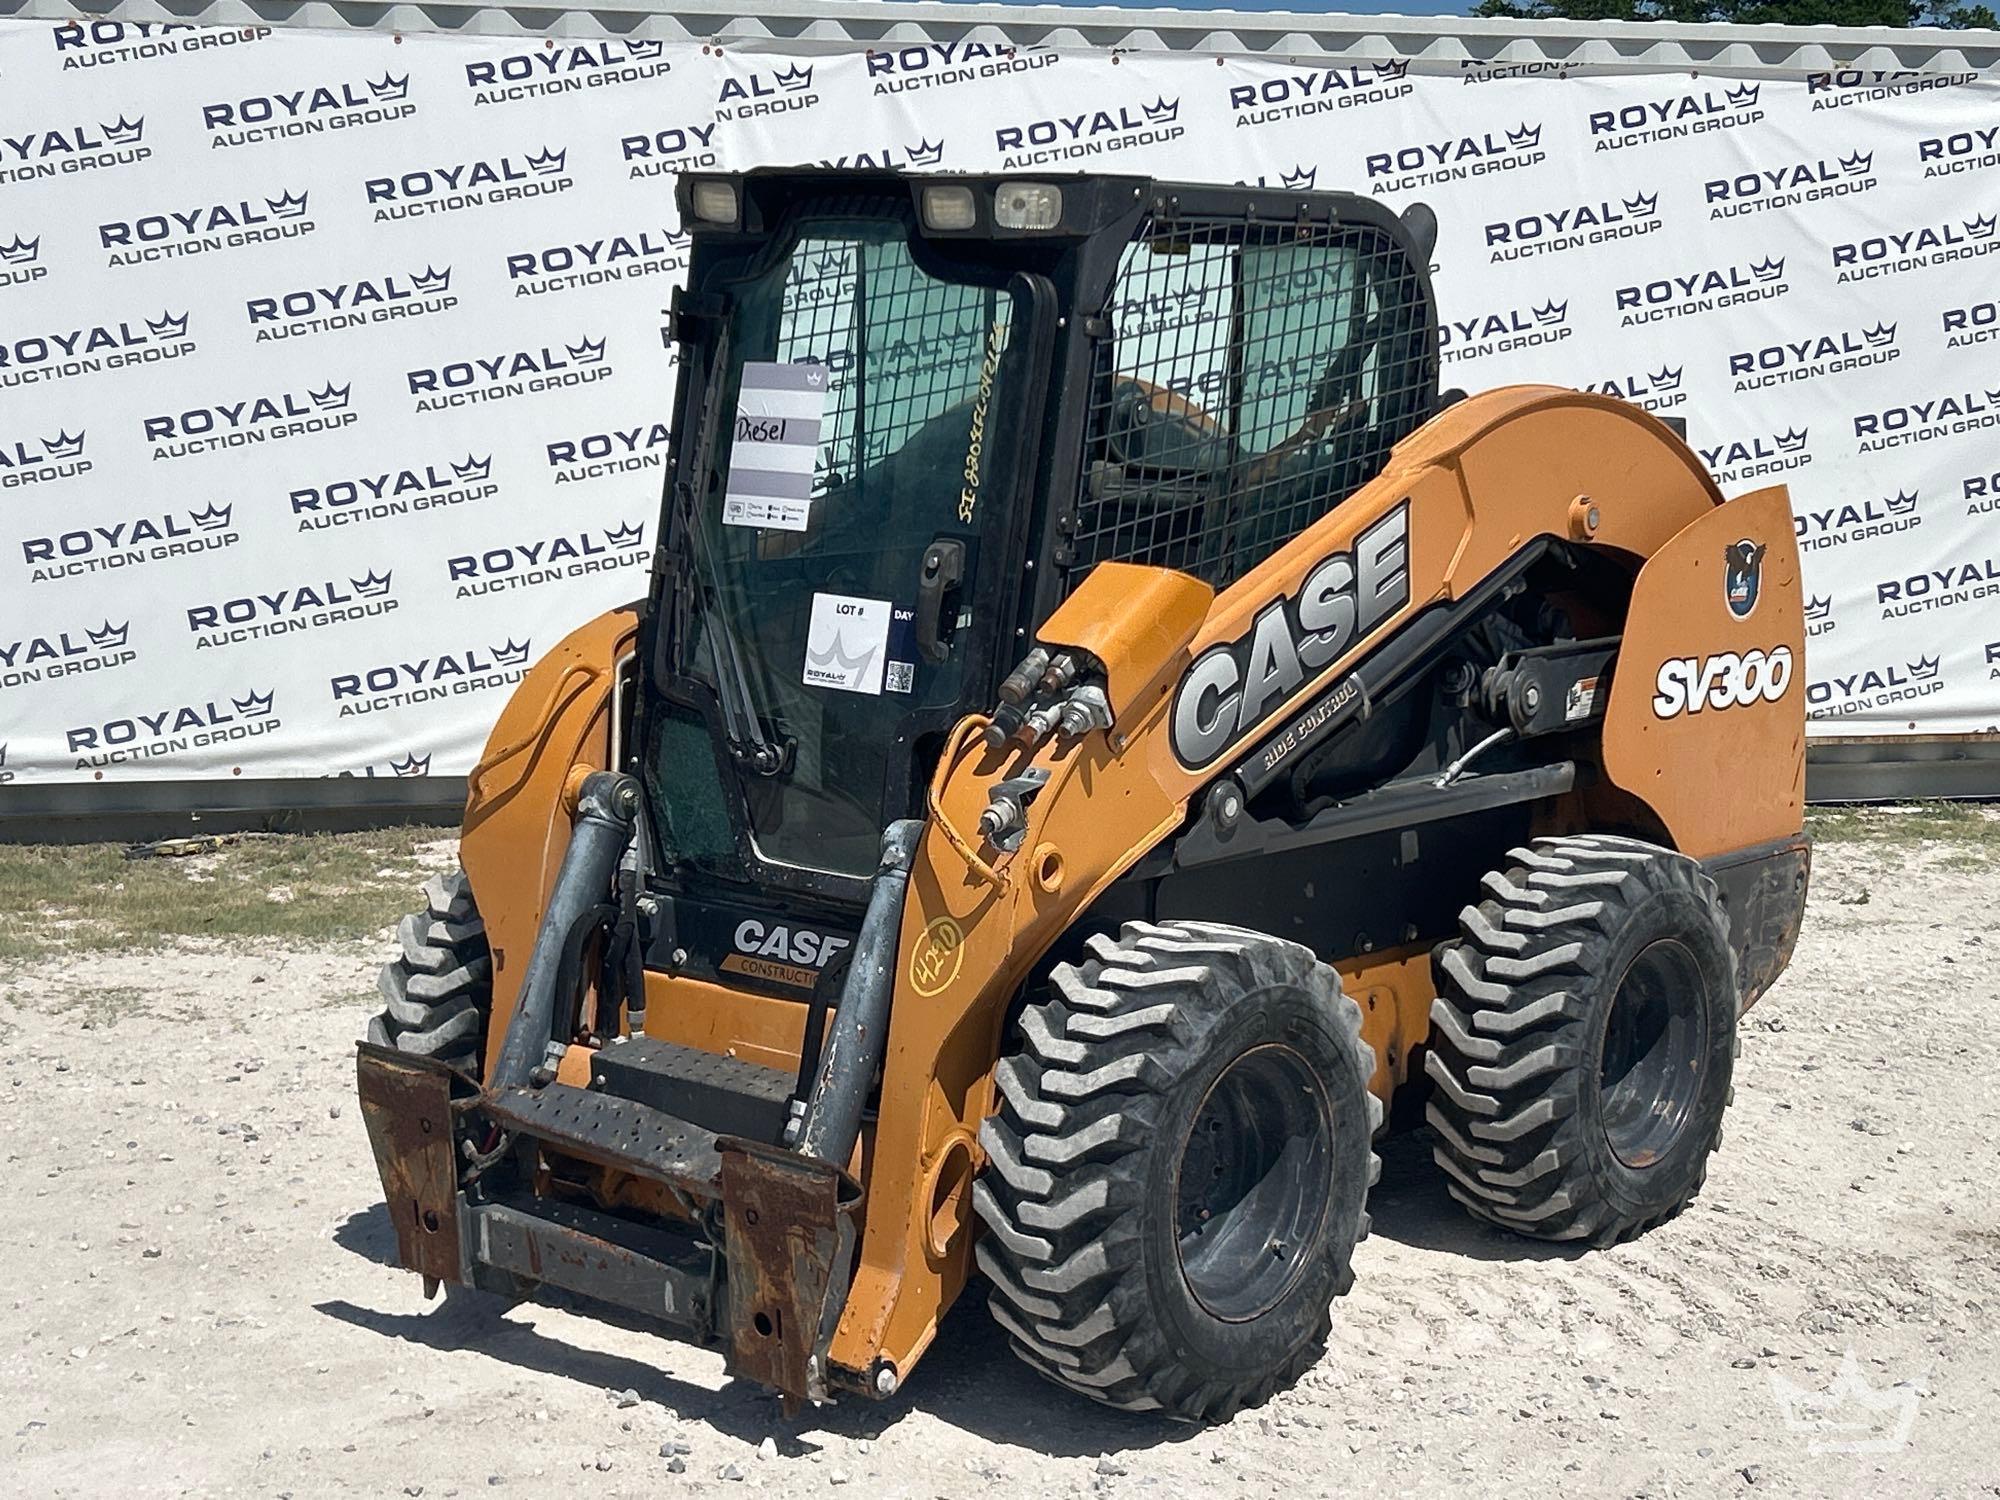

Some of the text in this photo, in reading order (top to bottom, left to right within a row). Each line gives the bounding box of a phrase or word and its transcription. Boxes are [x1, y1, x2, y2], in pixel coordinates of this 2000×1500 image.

[63, 27, 272, 70] AUCTION GROUP
[465, 41, 625, 87] ROYAL
[475, 63, 670, 106] AUCTION GROUP
[874, 54, 1059, 96] AUCTION GROUP
[1230, 65, 1374, 109] ROYAL
[1464, 62, 1559, 85] AUCTION
[1812, 73, 1979, 112] AUCTION GROUP
[203, 84, 369, 130] ROYAL
[212, 104, 416, 149] AUCTION GROUP
[738, 95, 819, 118] GROUP
[1236, 84, 1413, 127] AUCTION GROUP
[1590, 92, 1725, 134] ROYAL
[0, 127, 102, 163] YAL
[621, 123, 715, 161] ROY
[996, 107, 1142, 152] ROYAL
[1003, 127, 1184, 170] AUCTION GROUP
[1595, 111, 1764, 152] AUCTION GROUP
[1919, 127, 2000, 162] ROY
[0, 148, 151, 184] TION GROUP
[630, 153, 715, 179] AUCTIO
[1366, 134, 1506, 177] ROYAL
[1372, 152, 1545, 195] AUCTION GROUP
[365, 158, 527, 203] ROYAL
[375, 178, 573, 222] AUCTION GROUP
[1705, 161, 1839, 203] ROYAL
[1710, 178, 1877, 220] AUCTION GROUP
[99, 202, 267, 248] ROYAL
[109, 222, 315, 267] AUCTION GROUP
[1485, 203, 1623, 246] ROYAL
[1491, 220, 1662, 263] AUCTION GROUP
[1833, 225, 1964, 267] ROYAL
[0, 267, 47, 287] OUP
[507, 233, 664, 279] ROYAL
[1837, 256, 1927, 284] AUCTION
[247, 277, 411, 323] ROYAL
[516, 268, 622, 297] AUCTION
[1616, 267, 1750, 310] ROYAL
[256, 297, 458, 342] AUCTION GROUP
[1621, 284, 1788, 327] AUCTION GROUP
[1443, 328, 1572, 363] TION GROUP
[1730, 332, 1863, 376] ROYAL
[1947, 328, 2000, 348] AUCT
[0, 343, 196, 387] UCTION GROUP
[407, 348, 567, 394] ROYAL
[1735, 349, 1900, 393] AUCTION GROUP
[416, 367, 612, 413] AUCTION GROUP
[1636, 393, 1687, 411] OUP
[144, 394, 310, 442] ROYAL
[153, 413, 357, 460] AUCTION GROUP
[735, 416, 787, 442] Diesel
[1854, 394, 1985, 437] ROYAL
[547, 424, 671, 466] ROYA
[1699, 438, 1774, 468] YAL
[1859, 425, 1948, 454] AUCTION
[2, 461, 92, 488] GROUP
[555, 454, 660, 484] AUCTION
[1741, 454, 1811, 478] GROUP
[289, 466, 452, 514] ROYAL
[299, 485, 498, 532] AUCTION GROUP
[22, 515, 191, 564] ROYAL
[1800, 517, 1921, 552] TION GROUP
[32, 533, 239, 583] AUCTION GROUP
[448, 534, 606, 581] ROYAL
[456, 551, 651, 599] AUCTION GROUP
[187, 582, 351, 631] ROYAL
[197, 600, 398, 649] AUCTION GROUP
[836, 604, 856, 616] LOT
[894, 609, 915, 621] DAY
[1882, 591, 1968, 620] AUCTION
[0, 633, 87, 667] YAL
[1173, 502, 1409, 766] CASE
[47, 651, 136, 678] GROUP
[331, 651, 491, 700] ROYAL
[1652, 645, 1793, 720] SV300
[1805, 667, 1908, 704] OYAL
[340, 686, 447, 718] AUCTION
[1805, 681, 1944, 721] CTION GROUP
[66, 703, 233, 753] ROYAL
[75, 719, 280, 770] AUCTION GROUP
[1263, 681, 1359, 772] RIDE CONTROL
[741, 959, 818, 986] CONSTRUCTI
[915, 924, 957, 984] 4290
